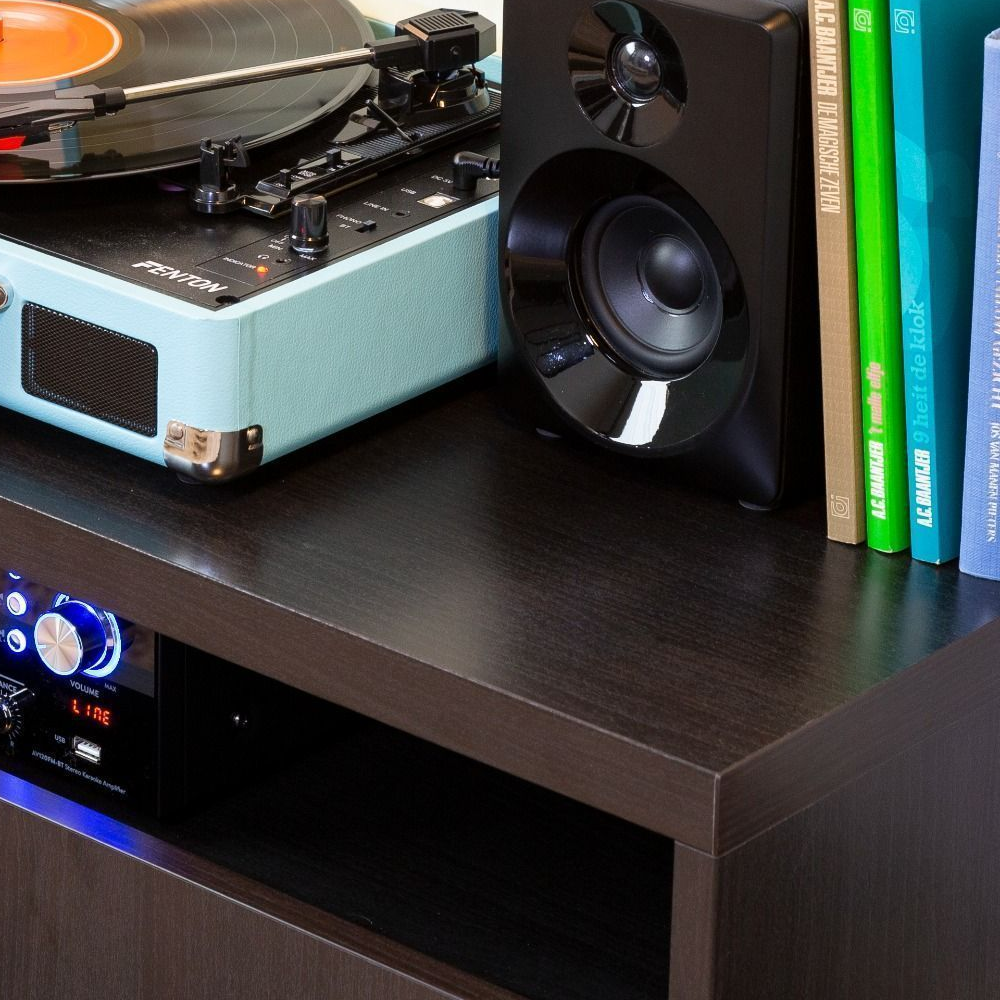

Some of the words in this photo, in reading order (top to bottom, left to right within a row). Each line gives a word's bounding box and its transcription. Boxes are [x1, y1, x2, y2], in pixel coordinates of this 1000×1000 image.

[814, 0, 835, 25] A.C.
[815, 26, 838, 97] BAANTJER
[817, 101, 838, 117] DE
[818, 117, 840, 176] MAGISCHE
[400, 187, 417, 195] USB
[820, 177, 841, 214] ZEVEN
[132, 260, 229, 293] FENTON
[908, 300, 926, 352] klok
[910, 354, 928, 380] de
[911, 384, 930, 429] heit
[912, 432, 930, 443] 9
[868, 440, 886, 499] BAANTJER
[914, 448, 932, 507] BAANTJER
[871, 499, 887, 520] A.C.
[916, 507, 933, 528] A.C.
[70, 679, 100, 698] VOLUME
[104, 682, 117, 693] MAX
[54, 733, 66, 743] USB
[65, 763, 82, 776] Stereo
[82, 771, 102, 785] Karaoke
[102, 780, 126, 795] Amplifier
